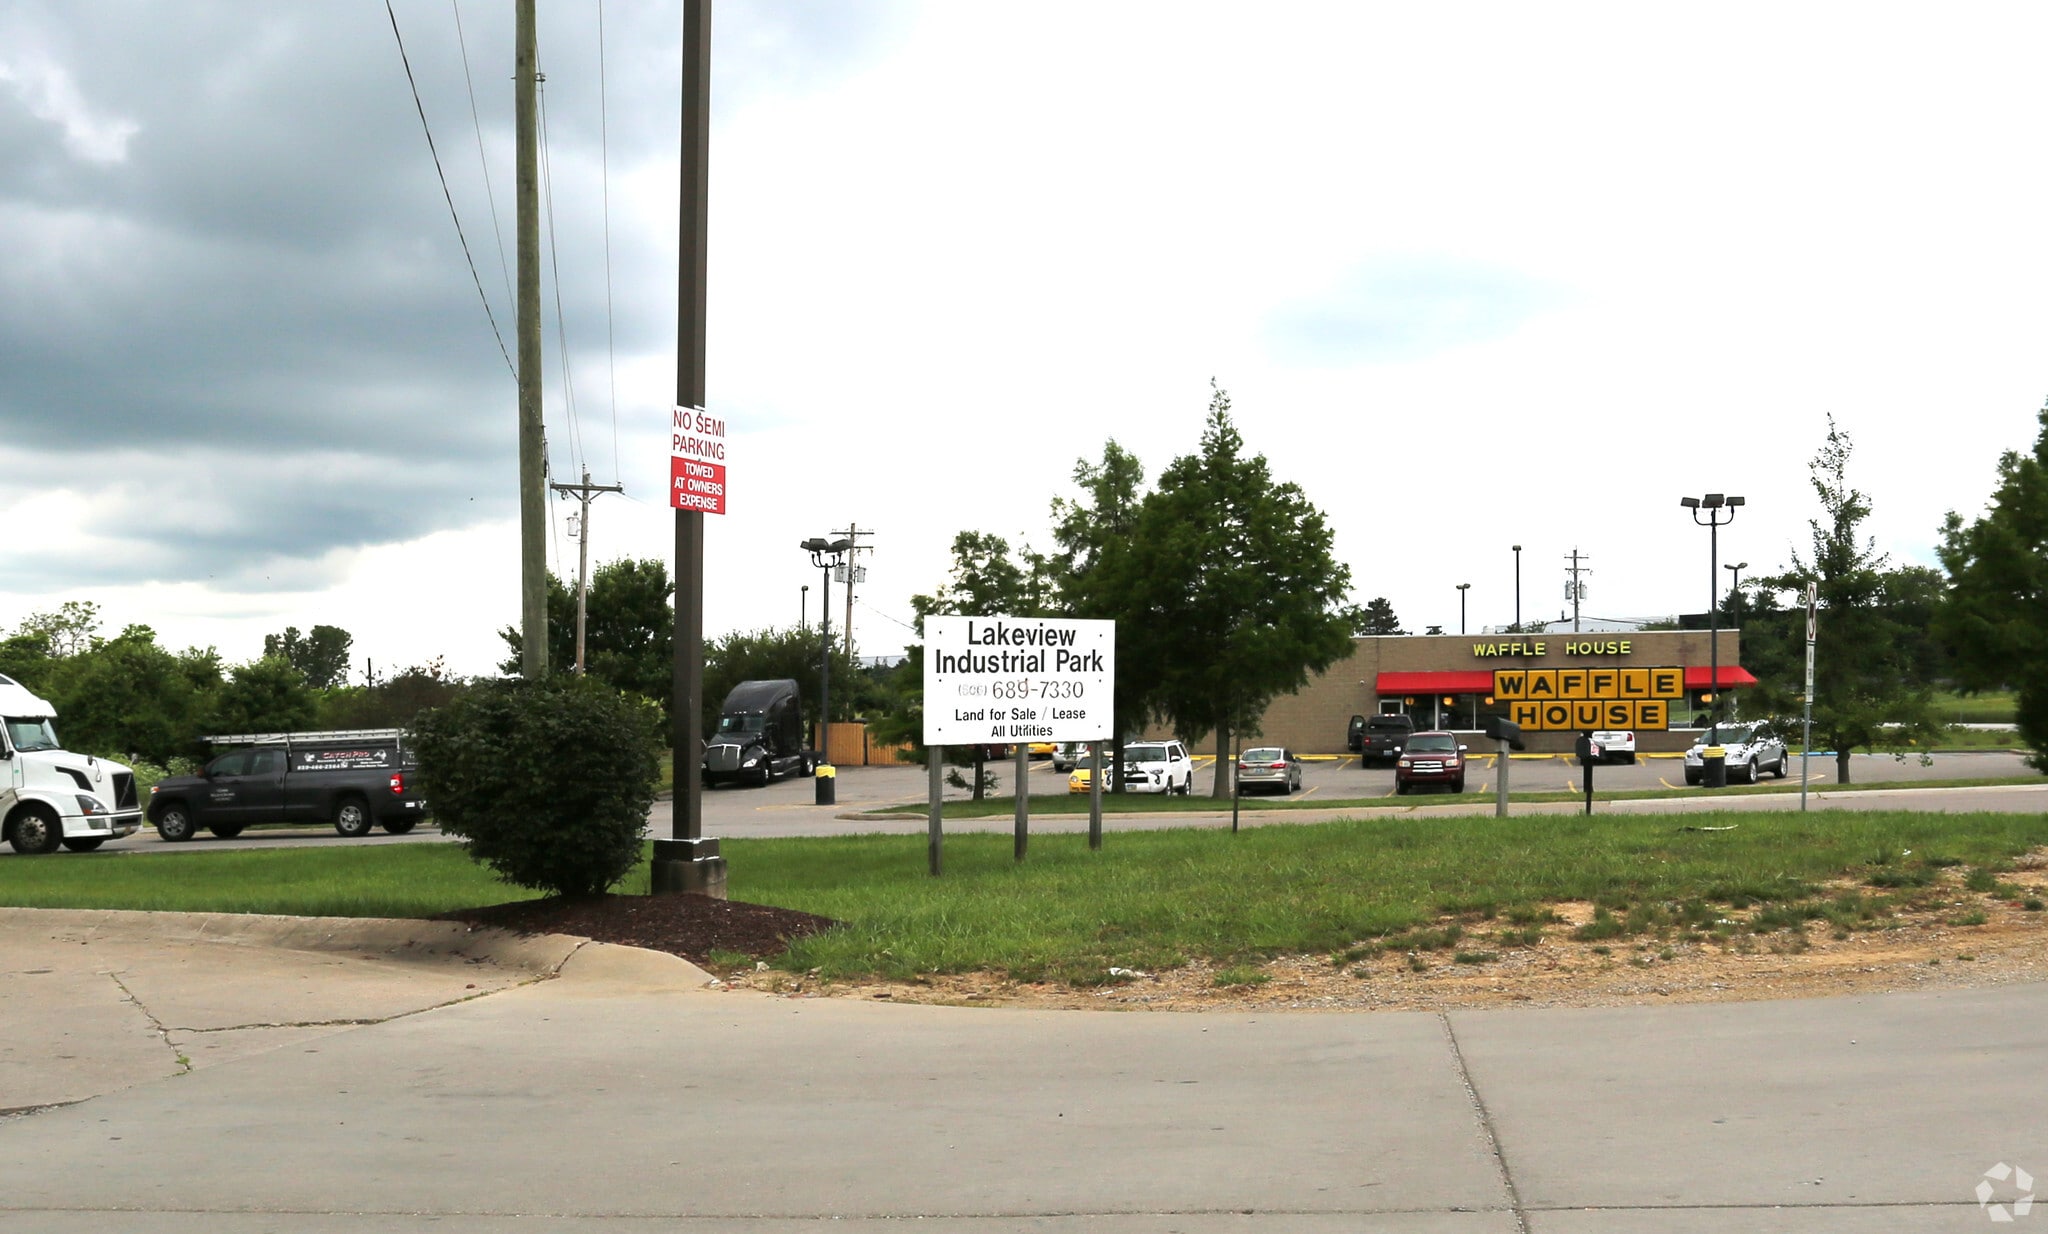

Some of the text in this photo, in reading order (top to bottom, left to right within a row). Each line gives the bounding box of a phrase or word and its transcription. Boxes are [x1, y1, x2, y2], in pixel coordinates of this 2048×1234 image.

[673, 409, 725, 438] NO SEMI
[672, 433, 725, 460] PARKING
[684, 462, 714, 479] TOWED
[674, 476, 723, 496] AT OWNERS
[679, 493, 718, 510] EXPENSE
[968, 621, 1076, 646] Lakeview
[1473, 641, 1632, 657] WAFFLE HOUSE
[936, 649, 1104, 674] Industrial Park
[992, 680, 1084, 699] 689-7330
[1498, 674, 1676, 695] WAFFLE
[955, 708, 984, 721] Land
[990, 707, 1006, 721] for
[1011, 707, 1037, 720] Sale
[1052, 707, 1086, 720] Lease
[1516, 704, 1660, 725] HOUSE
[991, 724, 1053, 738] All Utilities
